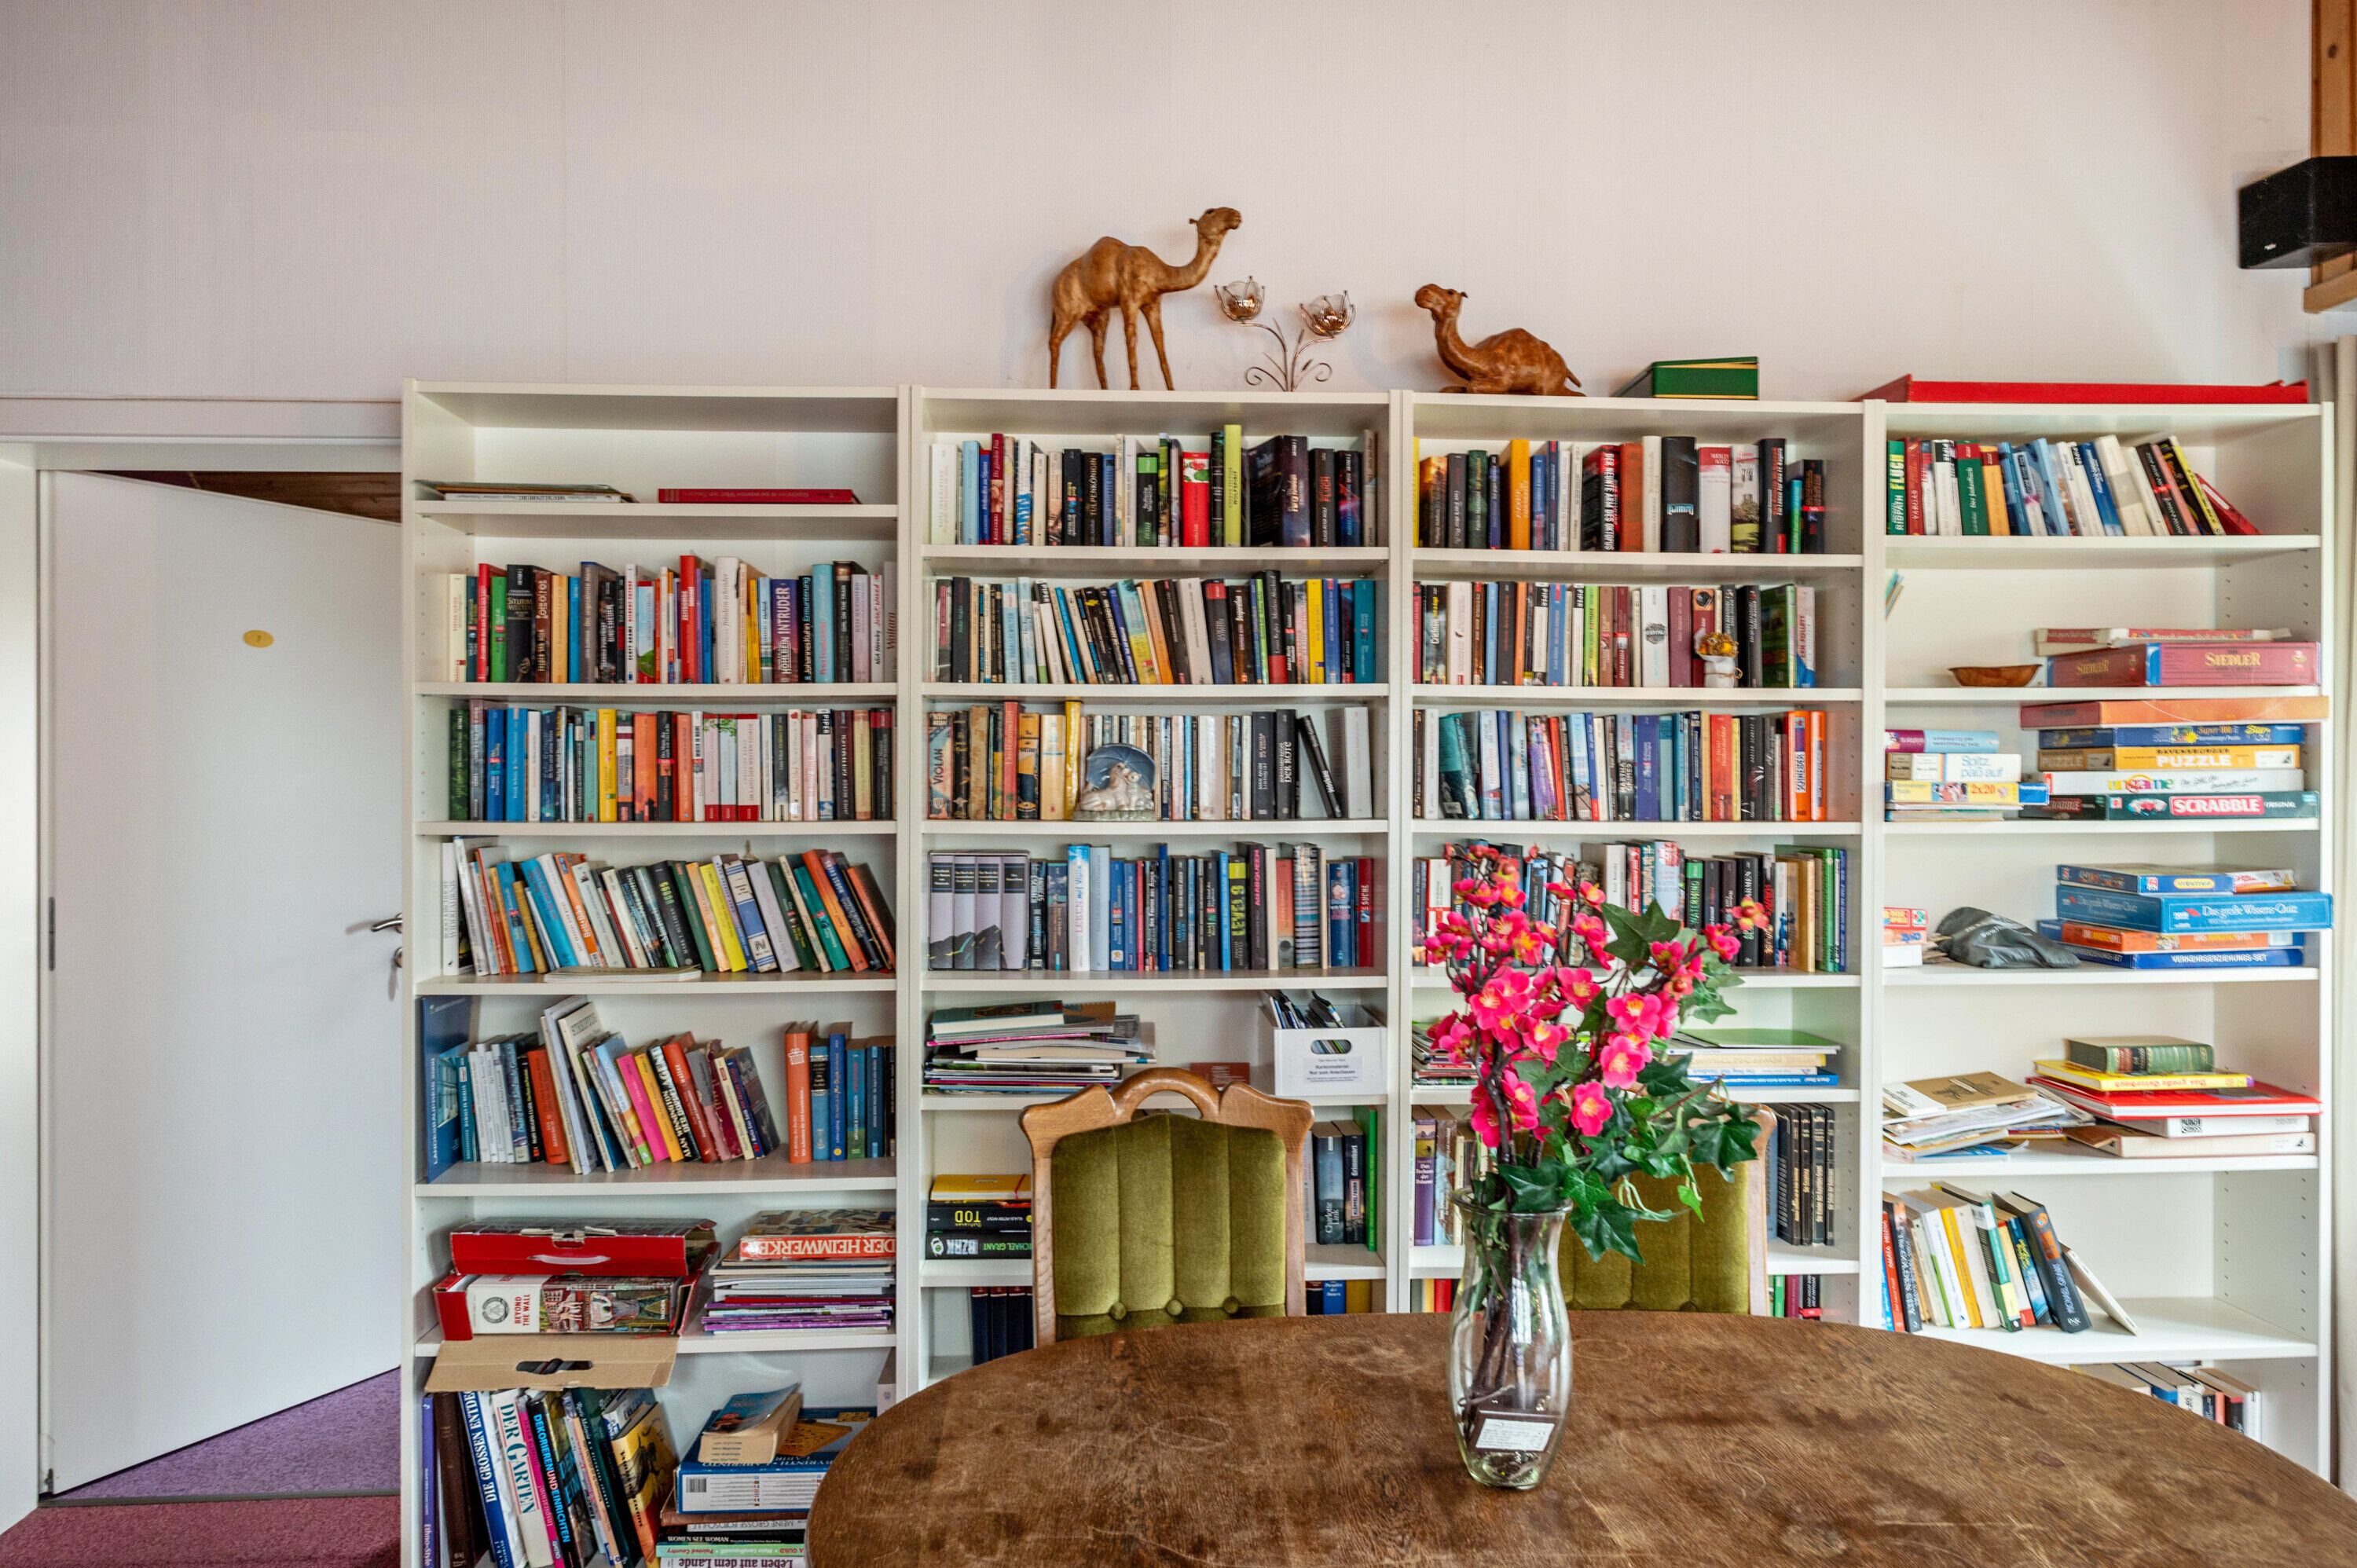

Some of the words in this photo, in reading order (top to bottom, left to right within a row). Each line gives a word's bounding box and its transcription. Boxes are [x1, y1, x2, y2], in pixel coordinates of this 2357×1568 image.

[1604, 452, 1615, 467] DER
[1604, 467, 1615, 492] NEUNTE
[1889, 454, 1904, 490] FLUCH
[1088, 457, 1098, 516] TULPENKÖNIGIN
[1604, 493, 1615, 507] ARM
[1911, 489, 1919, 520] VARGAS
[1604, 508, 1615, 522] DES
[1895, 494, 1904, 530] RIDPATH
[1604, 522, 1615, 550] OKTOPUS
[801, 577, 811, 622] Ermunterung
[775, 588, 791, 635] INTRUDER
[781, 636, 791, 675] HOHLBEIN
[2205, 652, 2262, 667] SIEDLER
[2076, 660, 2109, 676] SIEDLER
[1961, 756, 1990, 768] Spitz
[2040, 756, 2083, 768] PUZZLE
[2155, 754, 2232, 768] PUZZLE
[1796, 753, 1806, 793] SCHNEIDER
[1984, 767, 2004, 778] auf
[2172, 798, 2262, 814] SCRABBLE
[1252, 849, 1261, 906] ARABQUEEN
[1360, 885, 1369, 907] SUCHE
[1689, 881, 1699, 925] WATERMIND
[665, 1090, 684, 1136] WINNINGTON
[680, 1119, 691, 1134] DER
[681, 1138, 692, 1158] ALAN
[955, 1211, 981, 1222] TOD
[1324, 1202, 1333, 1233] Charlotte
[1331, 1208, 1340, 1225] Link
[863, 1239, 896, 1255] DER
[983, 1243, 1006, 1251] GRANT
[1898, 1251, 1910, 1291] GOLDEN
[1906, 1291, 1915, 1316] CITY
[2051, 1262, 2067, 1286] GRANT
[500, 1404, 519, 1440] DER
[471, 1431, 491, 1481] GROSSEN
[507, 1442, 537, 1514] GARTEN
[484, 1482, 498, 1504] DIE
[423, 1522, 432, 1566] Ethno-Style
[678, 1558, 712, 1568] Lande
[713, 1558, 735, 1568] dem
[739, 1558, 757, 1568] auf
[759, 1558, 794, 1568] Leben
